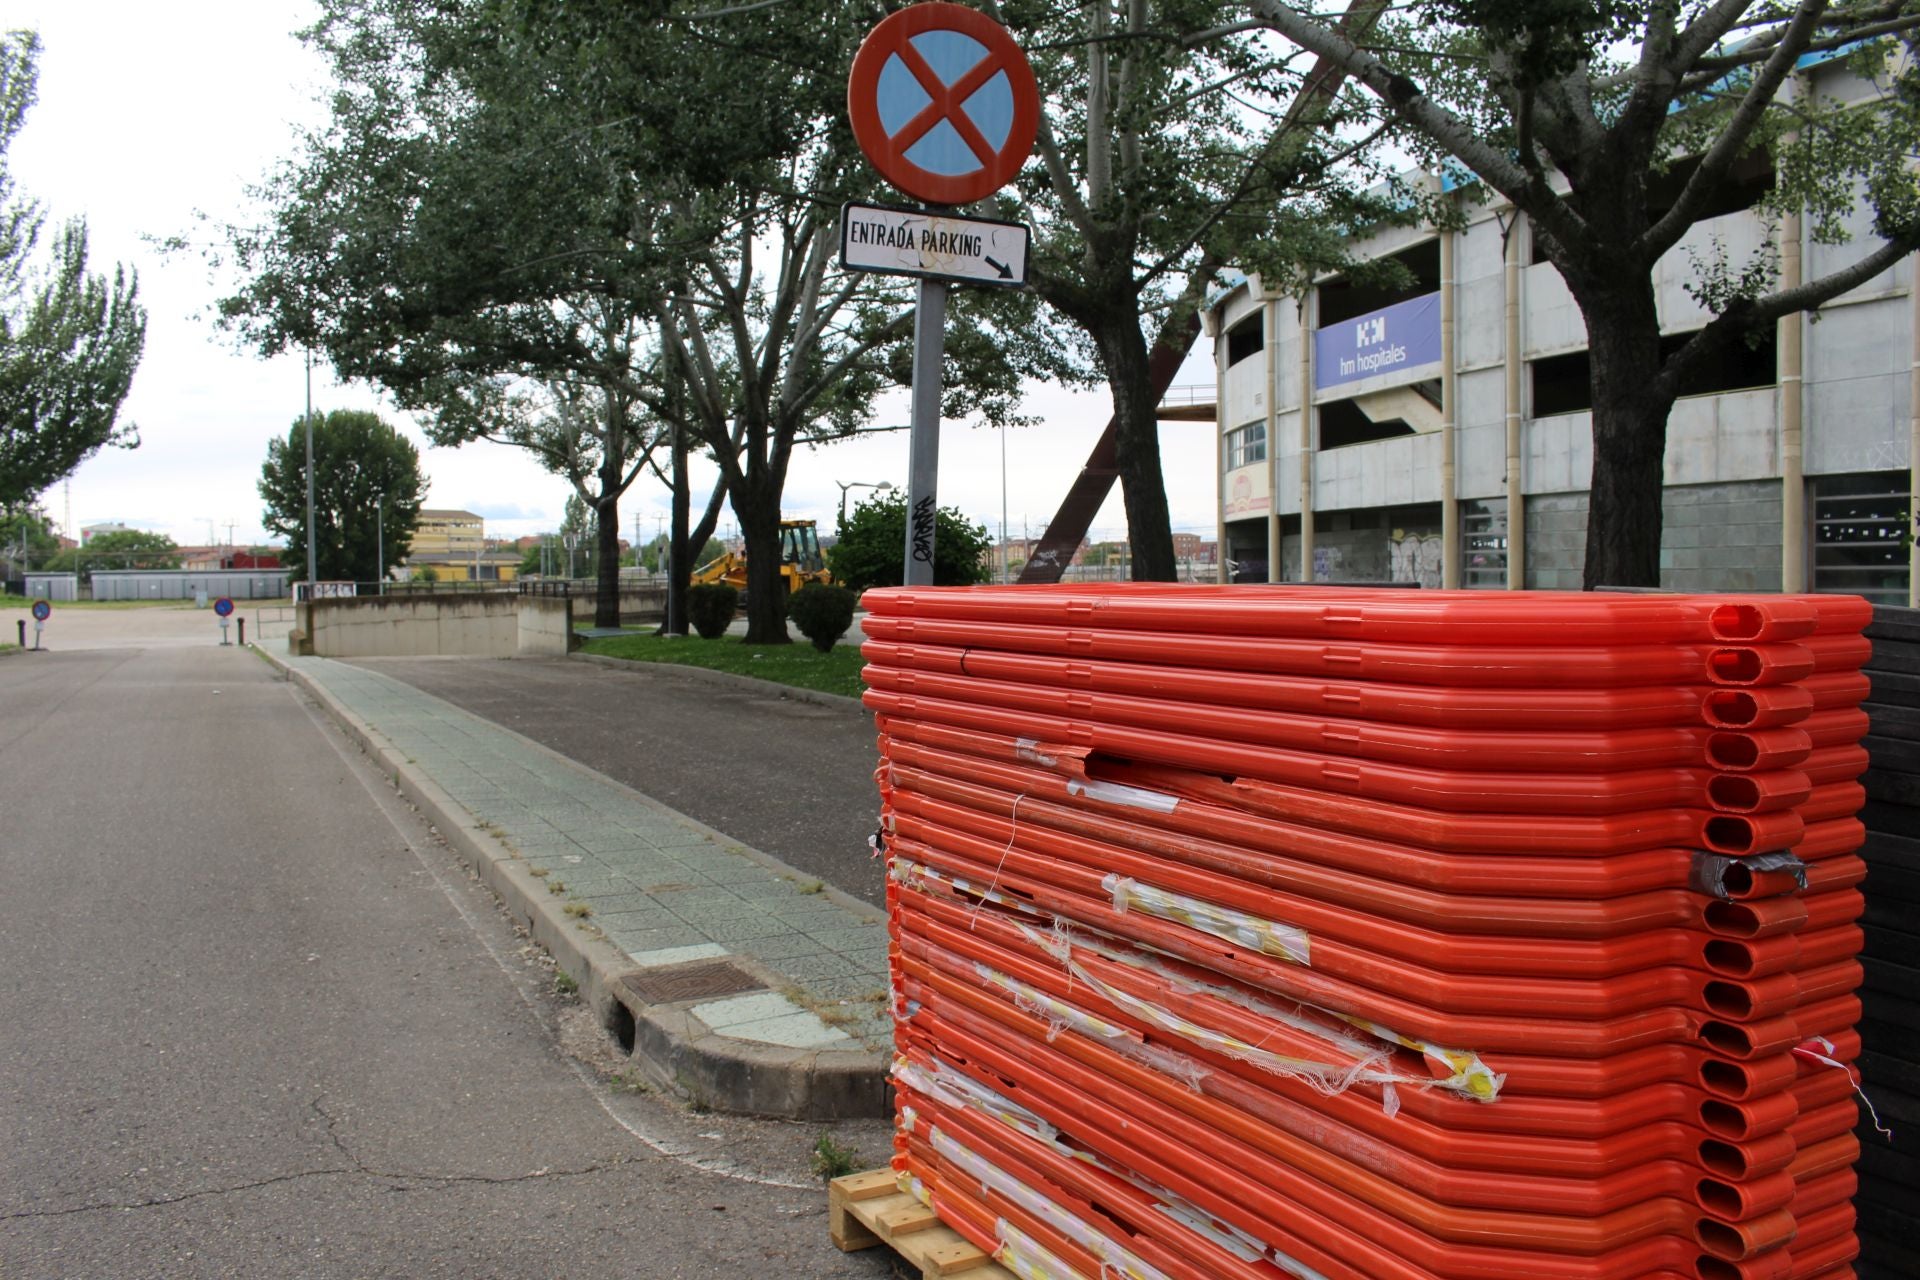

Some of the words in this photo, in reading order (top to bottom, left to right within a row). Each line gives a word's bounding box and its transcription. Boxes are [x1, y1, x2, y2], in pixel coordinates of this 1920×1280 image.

[851, 221, 915, 250] ENTRADA
[921, 229, 982, 257] PARKING
[1340, 357, 1355, 376] hm
[1357, 344, 1406, 373] hospitales
